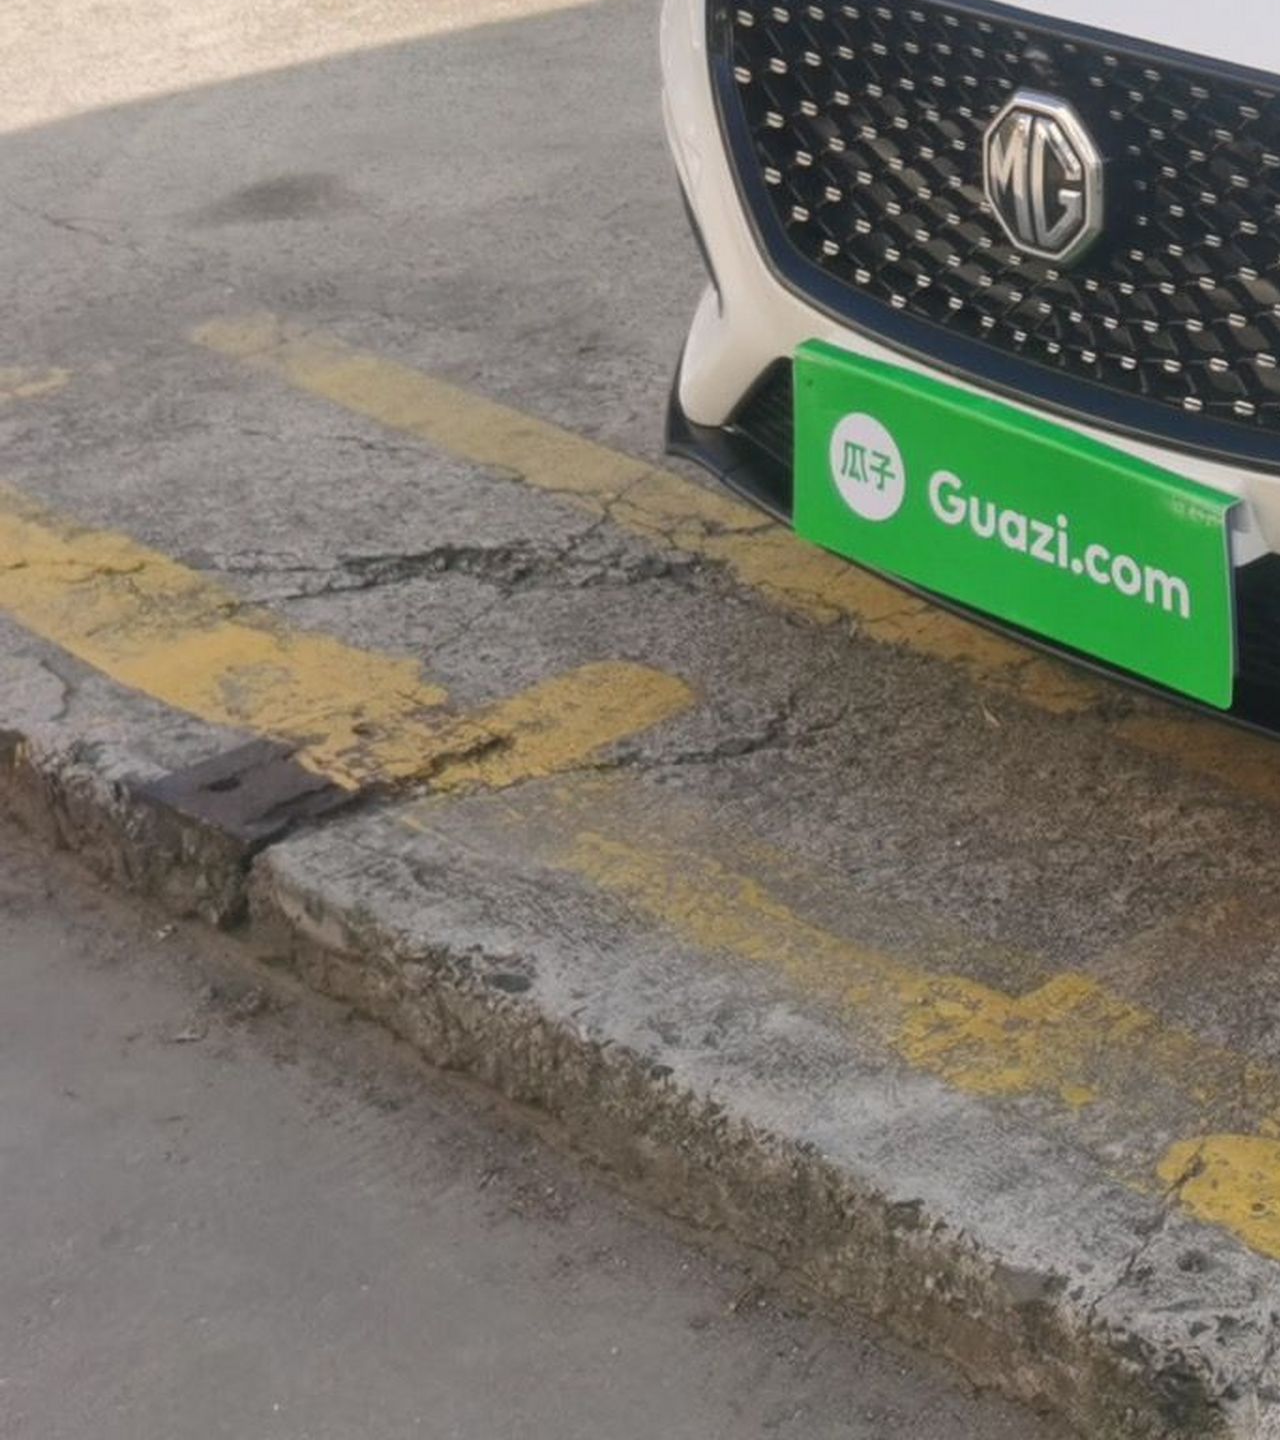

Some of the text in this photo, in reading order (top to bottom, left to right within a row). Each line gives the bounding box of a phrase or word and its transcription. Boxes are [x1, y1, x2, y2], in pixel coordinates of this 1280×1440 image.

[989, 113, 1083, 247] MG
[840, 440, 896, 491] 瓜子
[928, 470, 1190, 619] Guazi.com
